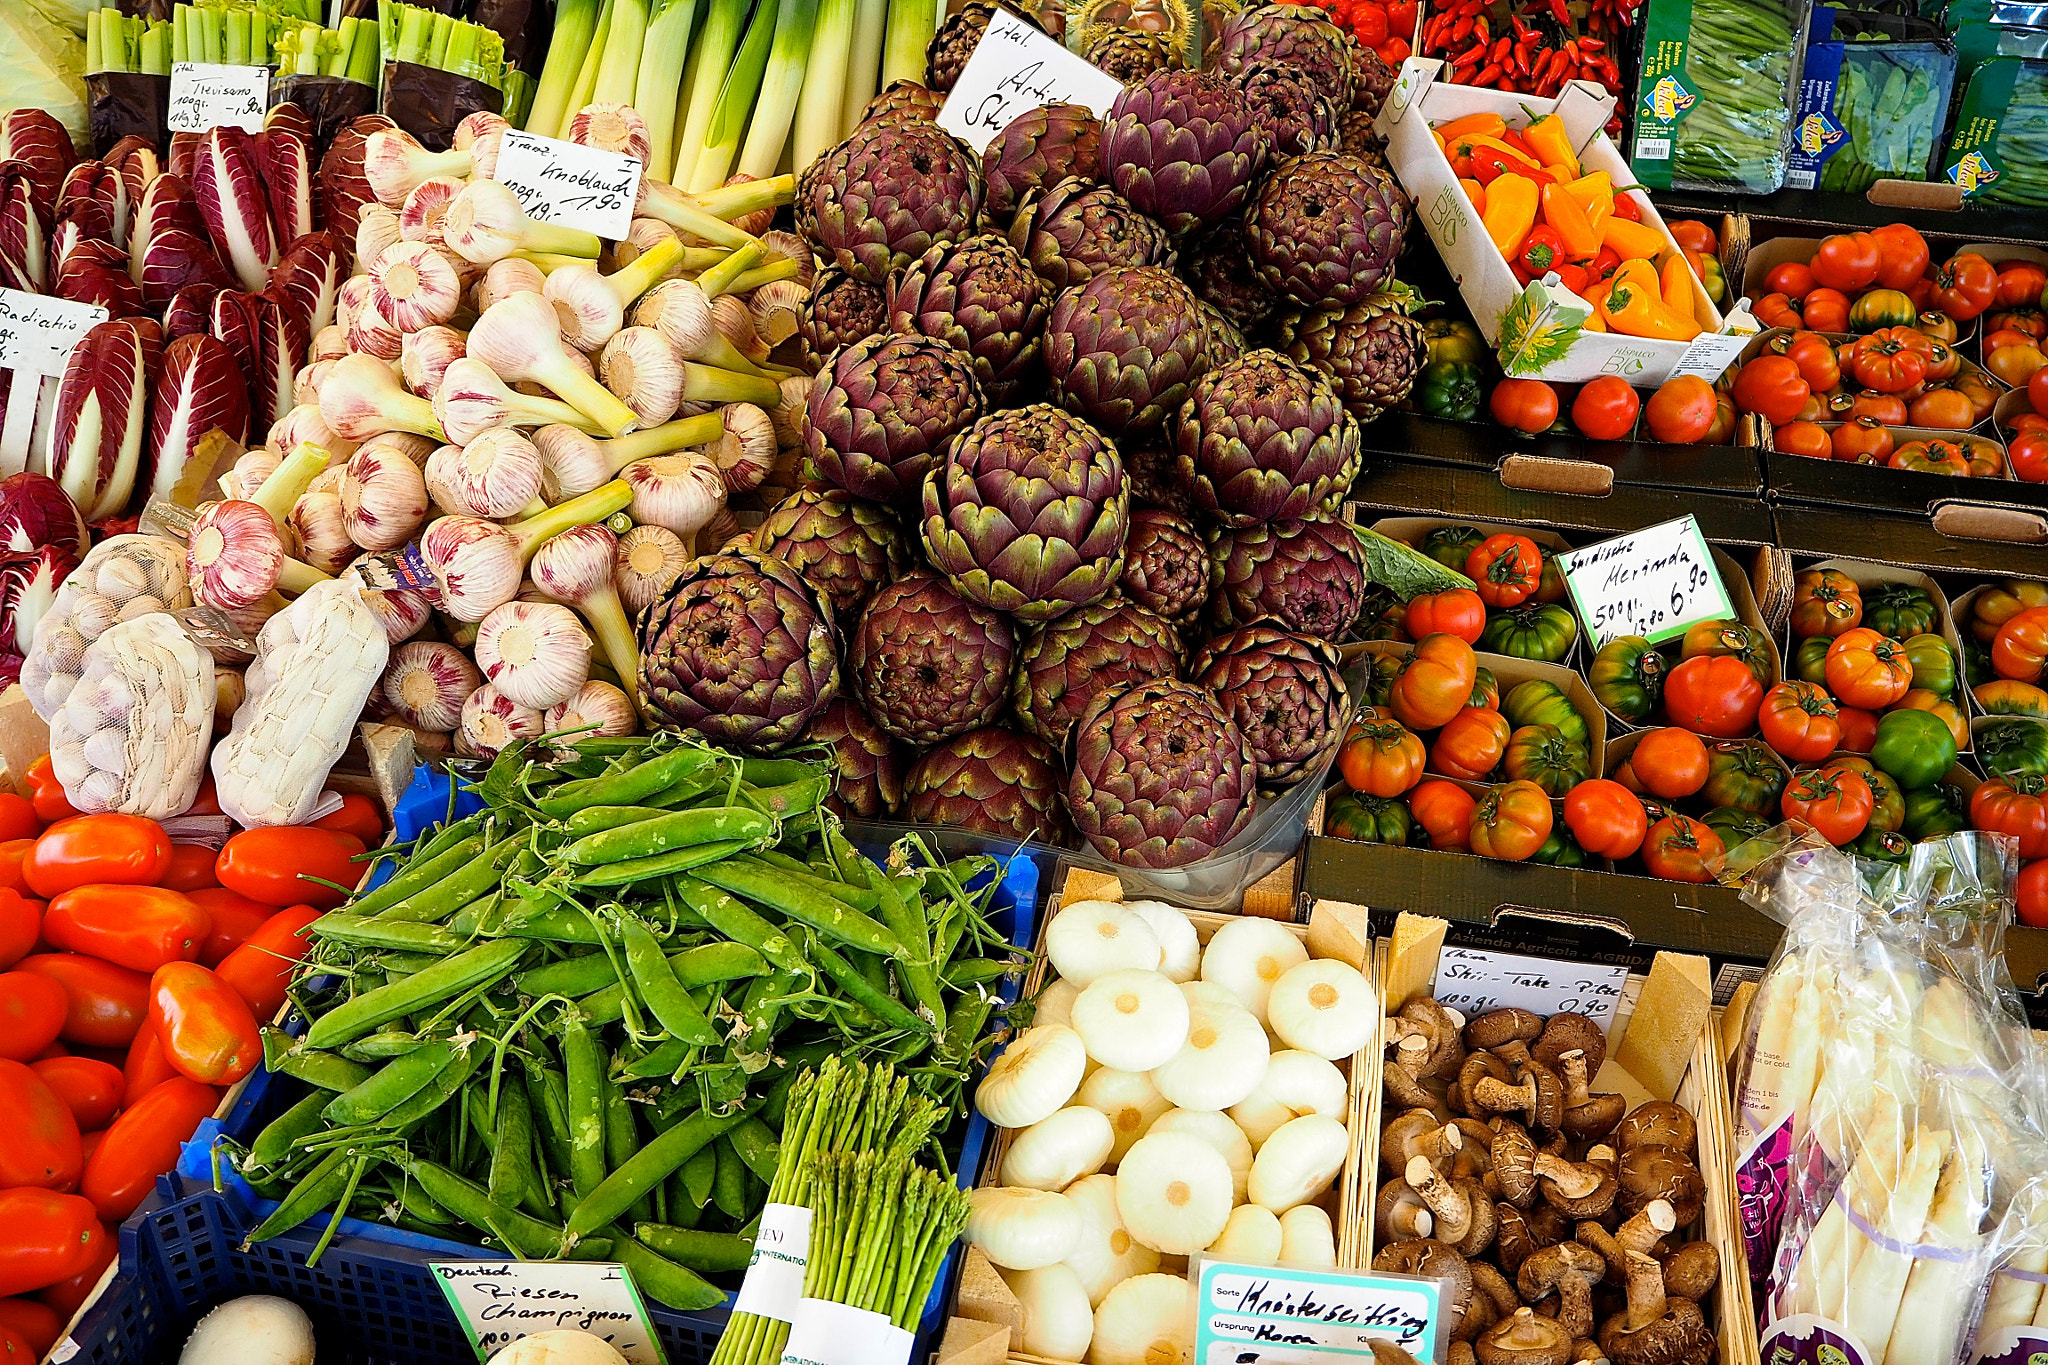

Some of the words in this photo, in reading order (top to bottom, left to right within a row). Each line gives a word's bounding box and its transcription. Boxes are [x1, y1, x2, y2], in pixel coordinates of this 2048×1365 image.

[540, 161, 632, 197] Knoblauch
[1451, 932, 1512, 949] Azienda
[1515, 941, 1578, 957] Agricola
[1216, 1287, 1240, 1298] Sorte
[1214, 1320, 1255, 1334] Ursprung
